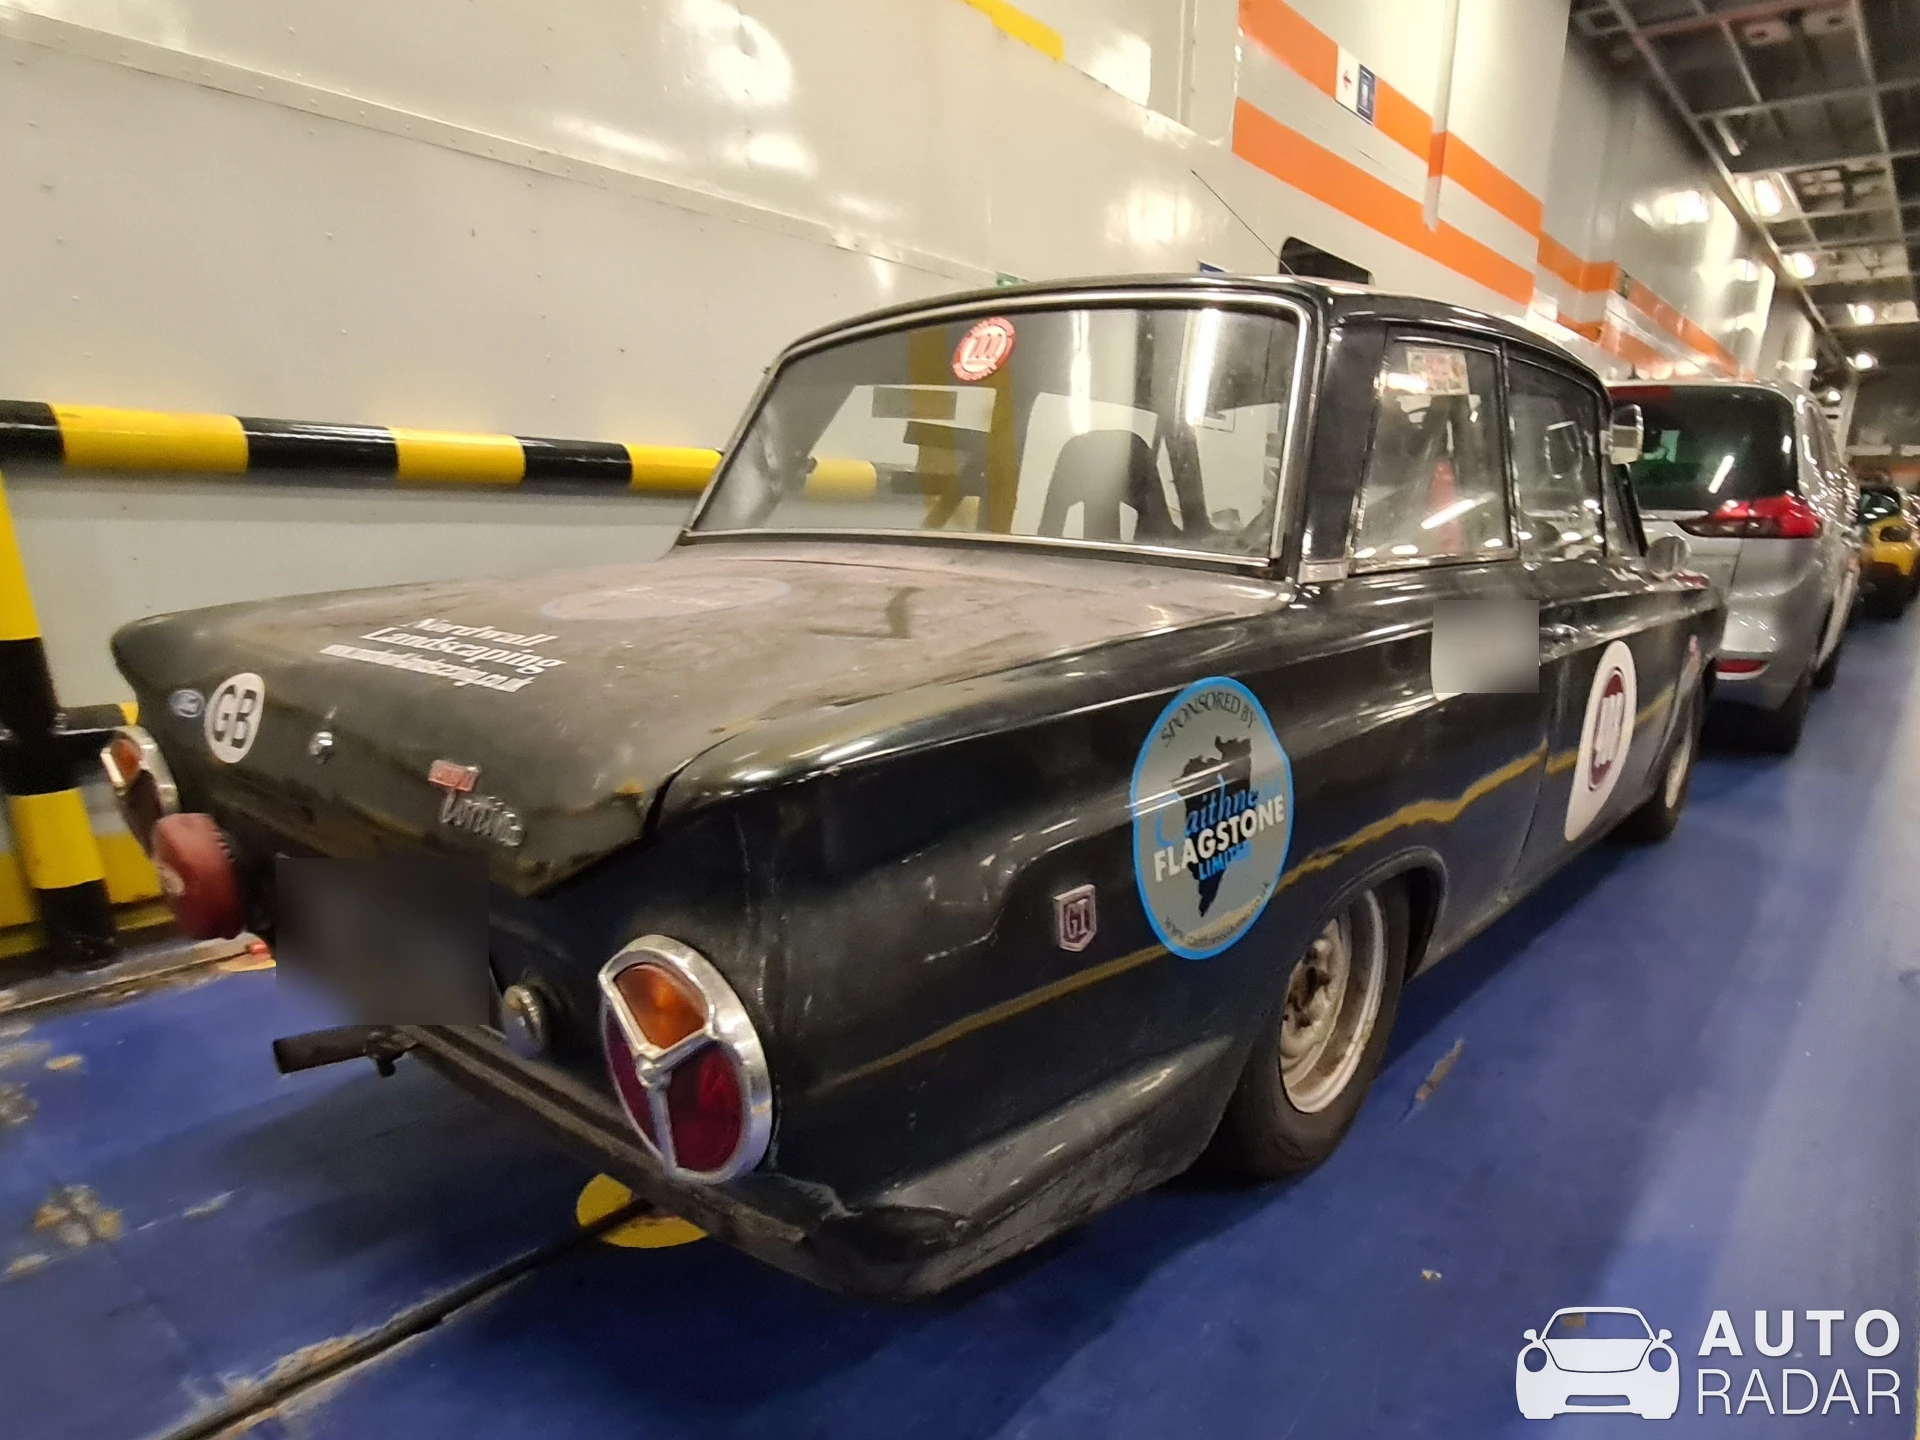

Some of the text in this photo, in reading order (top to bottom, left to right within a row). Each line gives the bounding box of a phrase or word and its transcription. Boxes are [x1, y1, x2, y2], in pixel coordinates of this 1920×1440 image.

[358, 626, 567, 675] Landscaping
[212, 683, 258, 750] GB
[1160, 691, 1255, 748] SPONSORED BY
[1153, 794, 1286, 882] FLAGSTONE
[1154, 771, 1281, 849] Caithne
[1064, 898, 1090, 940] GT
